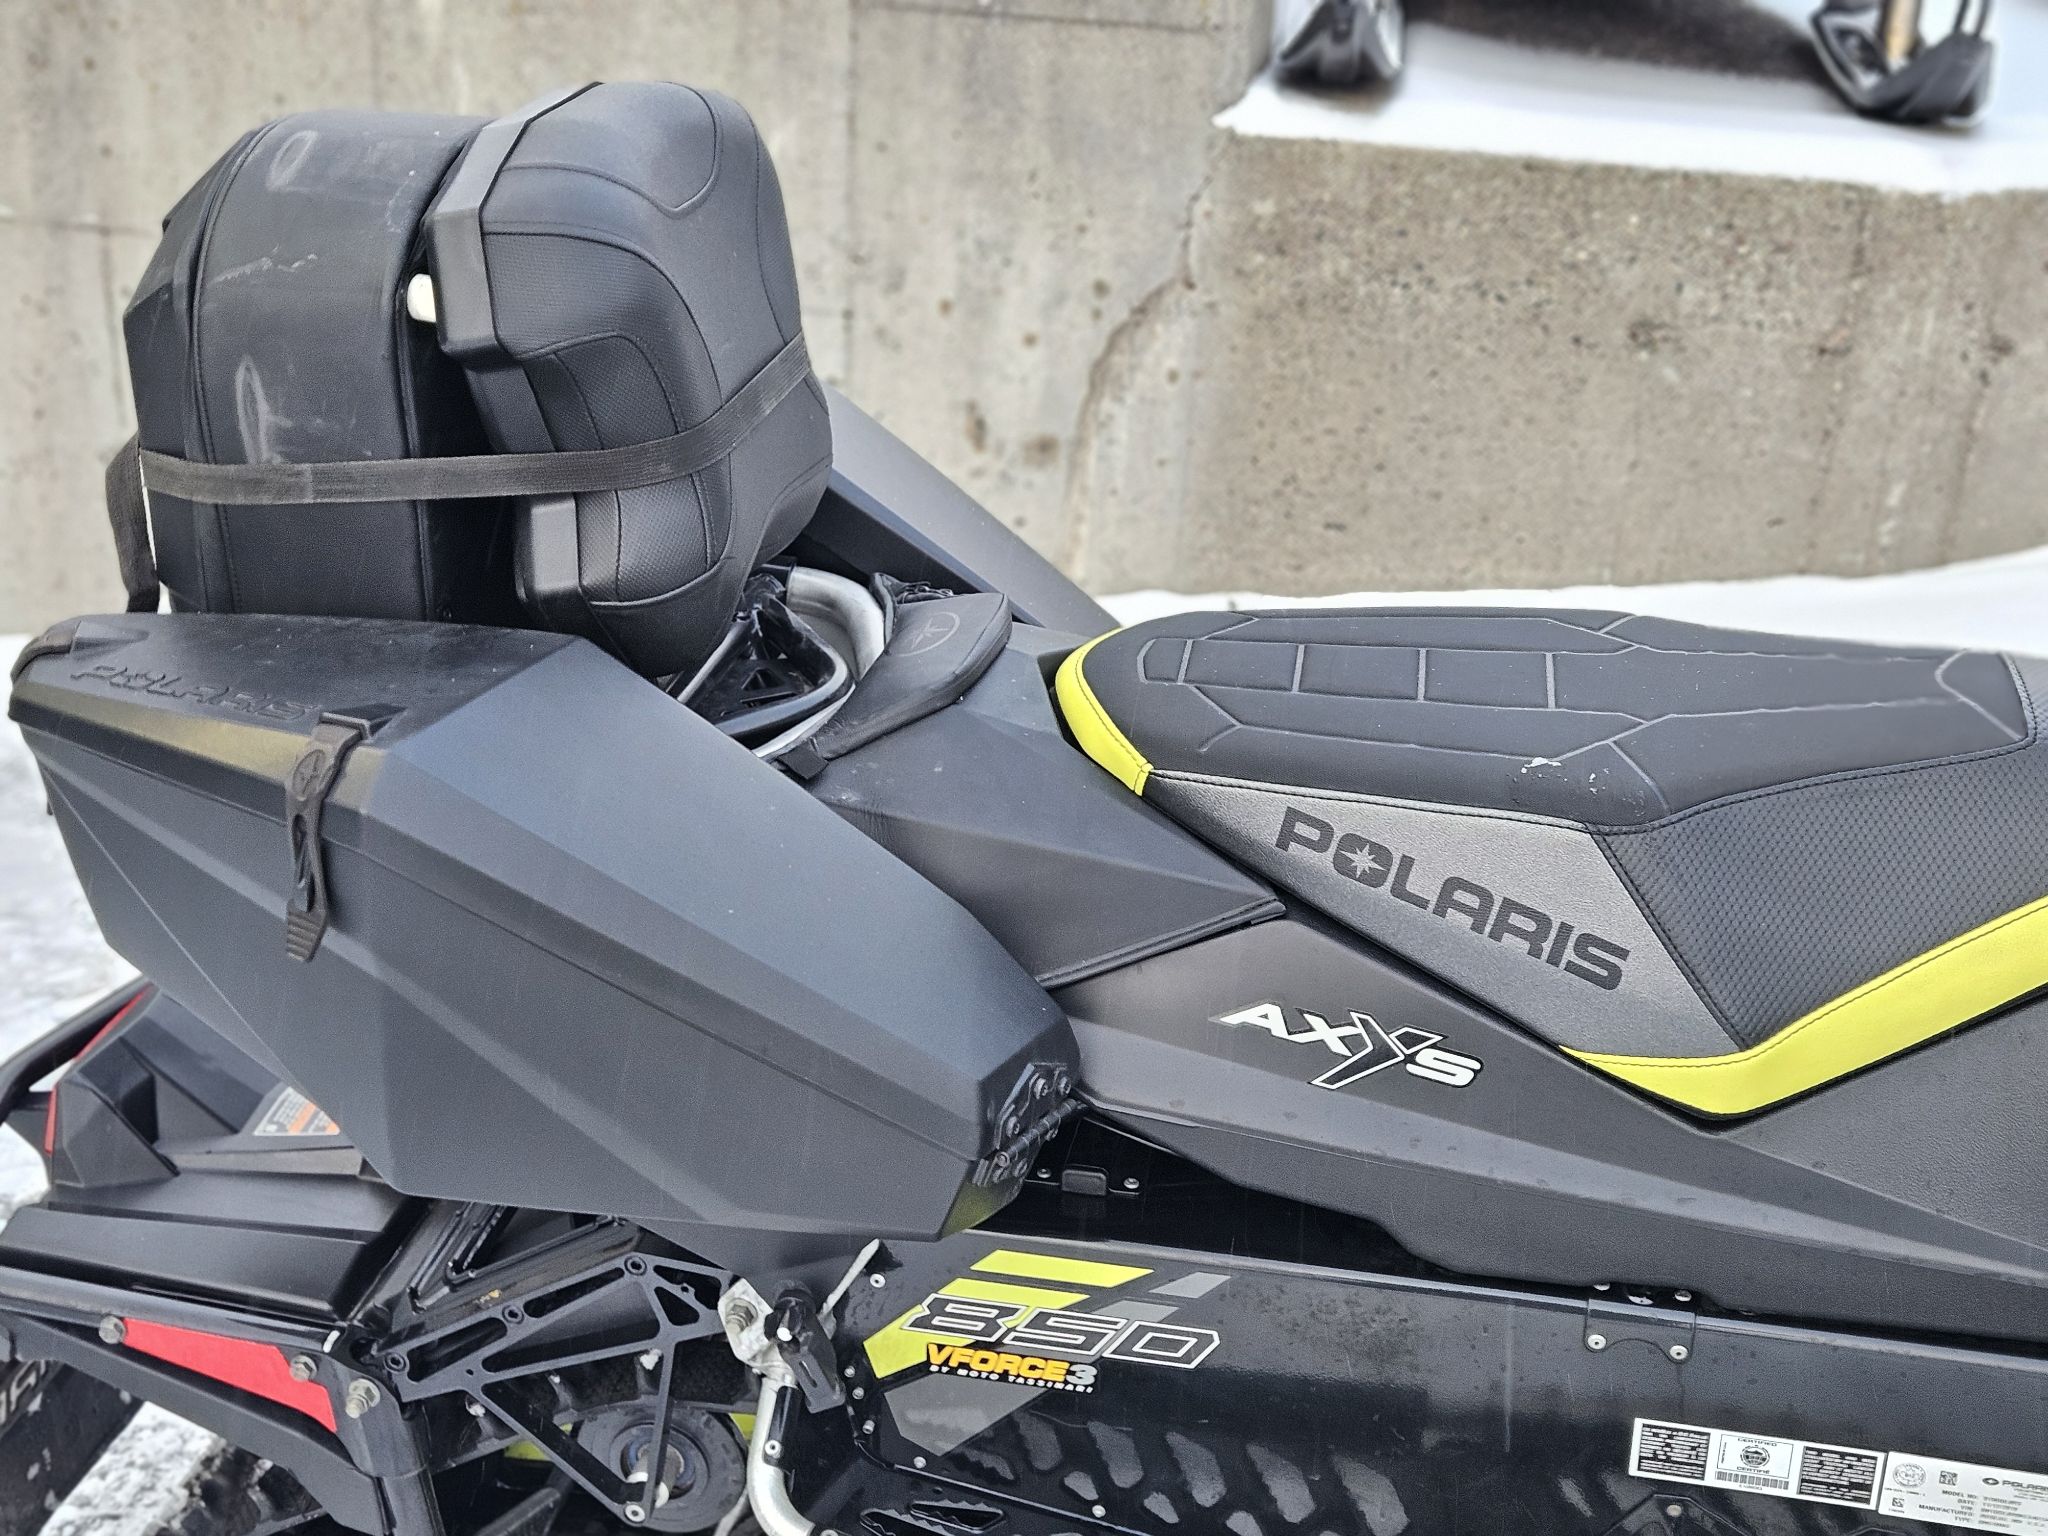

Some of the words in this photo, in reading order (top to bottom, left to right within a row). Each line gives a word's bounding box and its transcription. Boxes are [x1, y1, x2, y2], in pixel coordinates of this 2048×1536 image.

[1275, 806, 1630, 990] POLARIS
[900, 1293, 1221, 1369] 850
[929, 1365, 950, 1373] BY
[957, 1368, 1000, 1381] MOTO
[1008, 1375, 1094, 1394] TASSINARI
